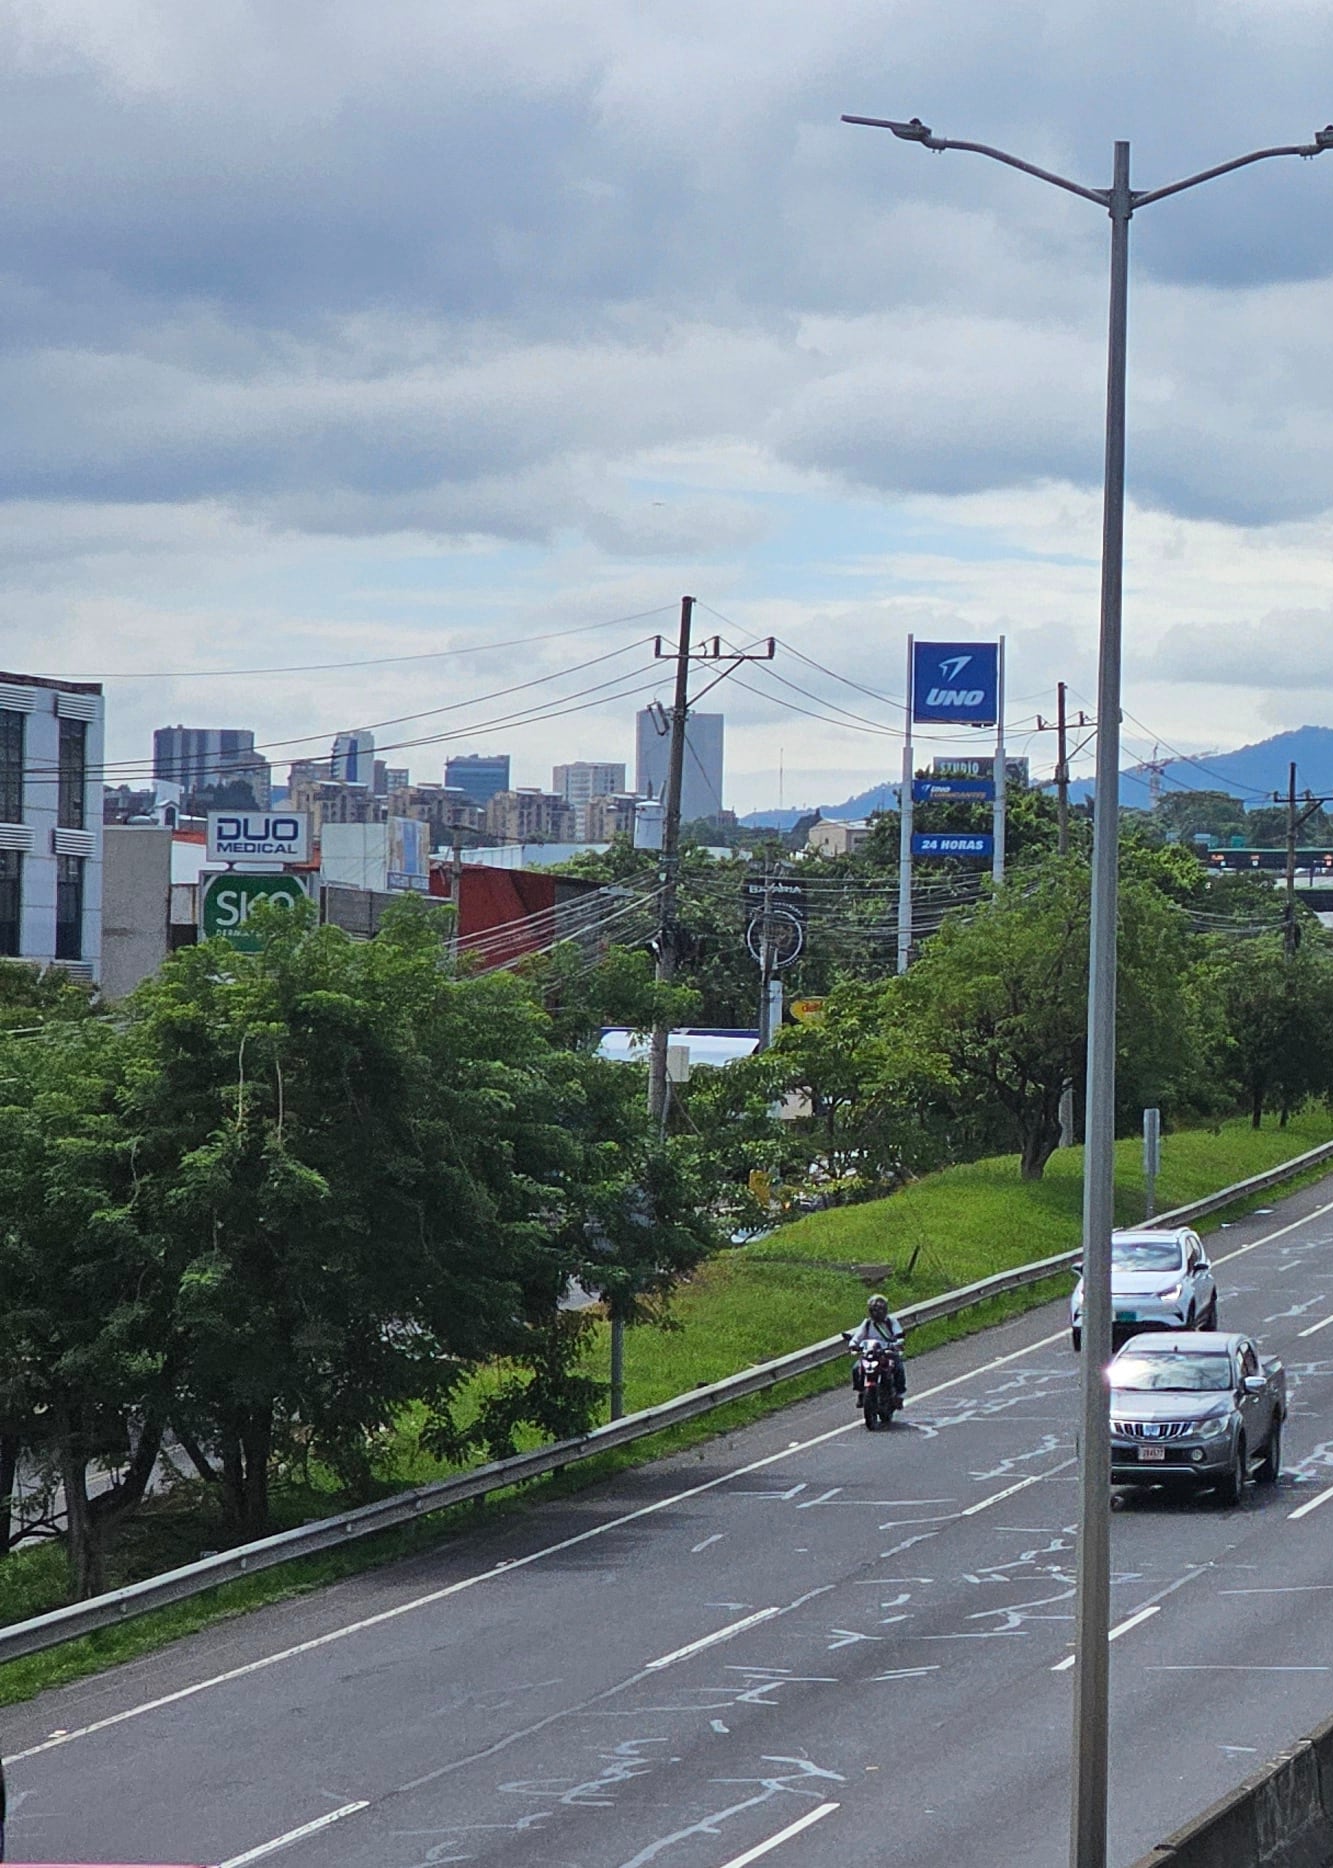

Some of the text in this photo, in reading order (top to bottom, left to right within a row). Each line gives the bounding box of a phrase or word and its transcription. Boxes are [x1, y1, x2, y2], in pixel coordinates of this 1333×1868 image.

[926, 688, 985, 706] UNO
[217, 818, 299, 841] DUO
[217, 842, 299, 854] MEDICAL
[921, 839, 984, 850] 24 HORAS
